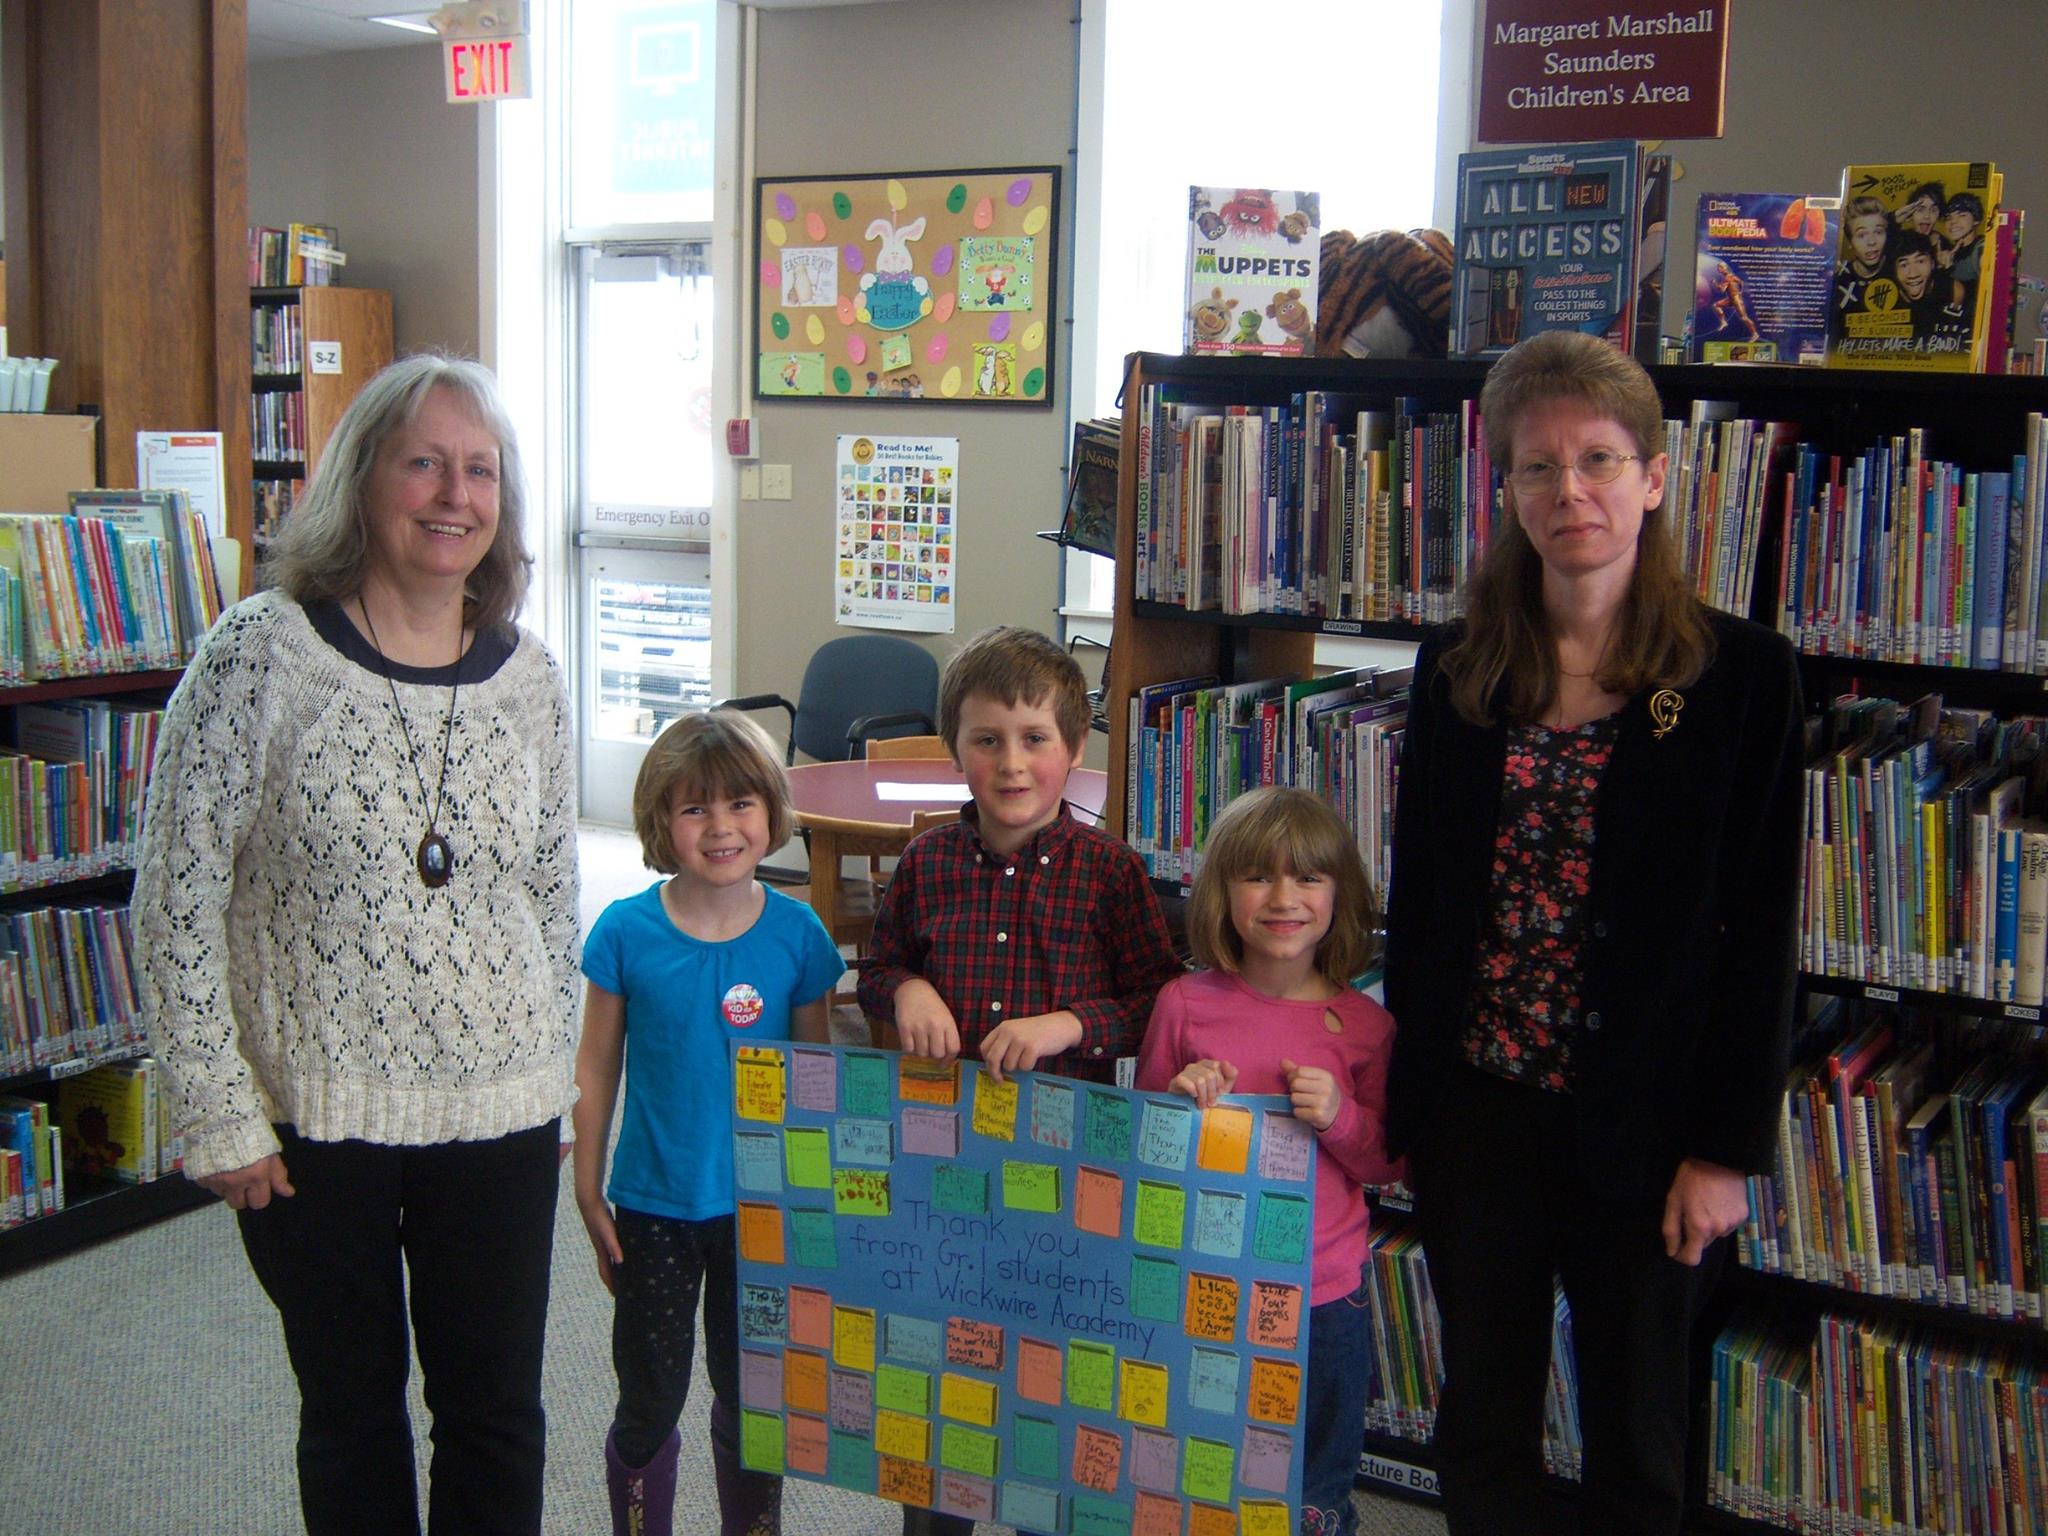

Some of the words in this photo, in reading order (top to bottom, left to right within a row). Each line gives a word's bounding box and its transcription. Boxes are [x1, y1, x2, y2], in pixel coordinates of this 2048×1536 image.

[1494, 20, 1600, 47] Margaret
[1606, 9, 1713, 38] Marshall
[452, 42, 512, 96] EXIT
[1544, 50, 1655, 75] Saunders
[1507, 83, 1624, 110] Children's
[1631, 82, 1690, 103] Area
[1528, 153, 1565, 165] Sports
[1483, 180, 1553, 215] ALL
[1567, 185, 1606, 205] NEW
[1709, 218, 1758, 228] ULTIMATE
[1465, 223, 1621, 260] ACCESS
[1195, 256, 1311, 277] MUPPETS
[1560, 264, 1583, 273] YOUR
[874, 281, 914, 300] Happy
[1543, 290, 1564, 299] PASS
[1567, 290, 1578, 298] TO
[1580, 290, 1597, 298] THE
[1534, 301, 1572, 311] COOLEST
[1573, 300, 1605, 310] THINGS
[1546, 313, 1556, 321] IN
[1557, 312, 1591, 321] SPORTS
[1858, 312, 1907, 324] SECONDS
[1868, 326, 1912, 335] SUMMER
[315, 352, 336, 364] S-Z
[1139, 425, 1150, 479] Children's
[1139, 482, 1149, 521] BOOK
[1345, 489, 1353, 524] BRITISH
[596, 507, 665, 527] Emergency
[670, 511, 694, 525] Exit
[1721, 506, 1734, 547] ACTIVITIES
[1138, 532, 1148, 558] art
[1344, 525, 1353, 563] CASTLES
[1990, 495, 2004, 570] READ-ALOUD
[1787, 543, 1799, 606] SNOWBOARDING
[1987, 571, 2000, 618] CLASSICS
[1324, 622, 1360, 631] DRAWING
[1129, 743, 1137, 773] NATURE
[1263, 761, 1271, 783] That!
[1128, 774, 1136, 804] CRAFTS
[2021, 850, 2031, 872] Love
[2030, 843, 2040, 880] Children
[1868, 989, 1896, 1000] PLAYS
[2007, 1007, 2039, 1018] JOKES
[54, 1065, 84, 1078] More
[87, 1051, 127, 1068] Picture
[1851, 1105, 1865, 1137] Roald
[1854, 1143, 1867, 1170] Dahl
[1860, 1185, 1872, 1210] VILE
[903, 1200, 1008, 1245] Thank
[1024, 1231, 1080, 1263] you
[1862, 1213, 1875, 1253] VERSES
[2021, 1215, 2030, 1237] THEN
[851, 1224, 923, 1261] from
[937, 1238, 974, 1270] Gr.
[996, 1249, 1126, 1305] students
[2024, 1244, 2032, 1268] NOW
[881, 1263, 921, 1292] at
[934, 1266, 1040, 1320] Wickwire
[1051, 1294, 1156, 1361] Academy
[1360, 1459, 1403, 1482] cture
[1410, 1468, 1441, 1492] Boo
